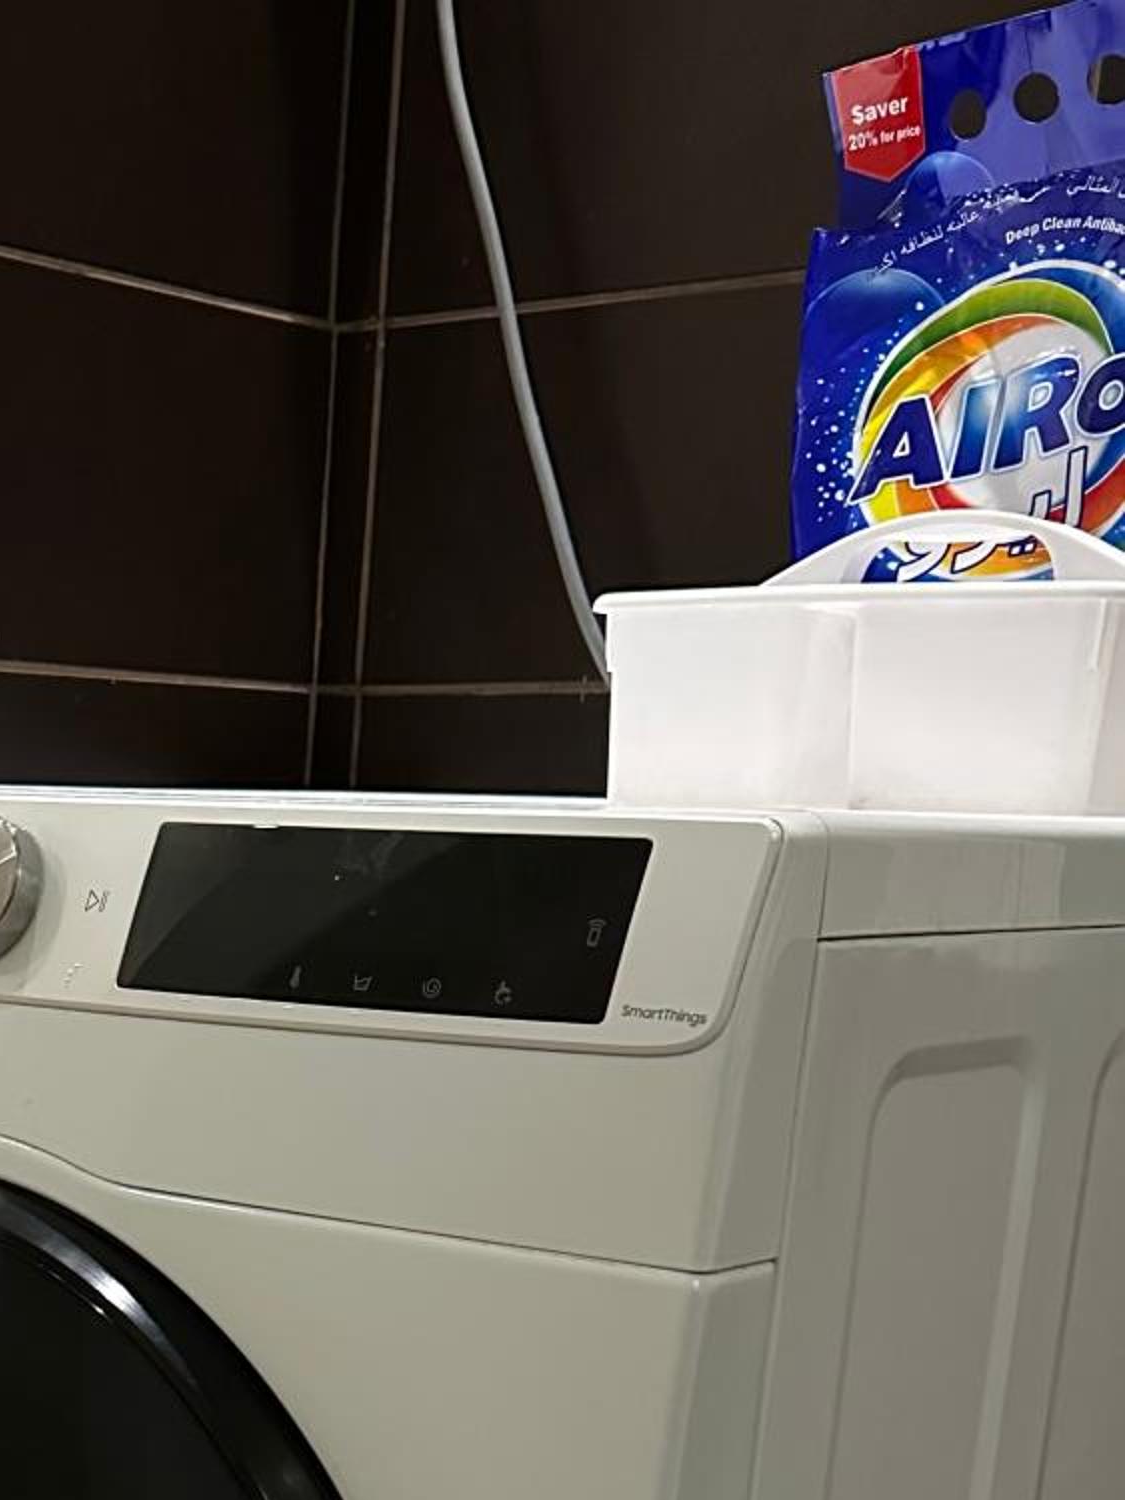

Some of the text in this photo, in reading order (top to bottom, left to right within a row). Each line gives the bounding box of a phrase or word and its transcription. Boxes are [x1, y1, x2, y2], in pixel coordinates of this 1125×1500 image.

[851, 97, 909, 126] Saver
[848, 125, 922, 152] 20% for price
[1005, 223, 1040, 245] Deep
[1042, 217, 1082, 231] Clean
[621, 1004, 707, 1027] SmartThings
